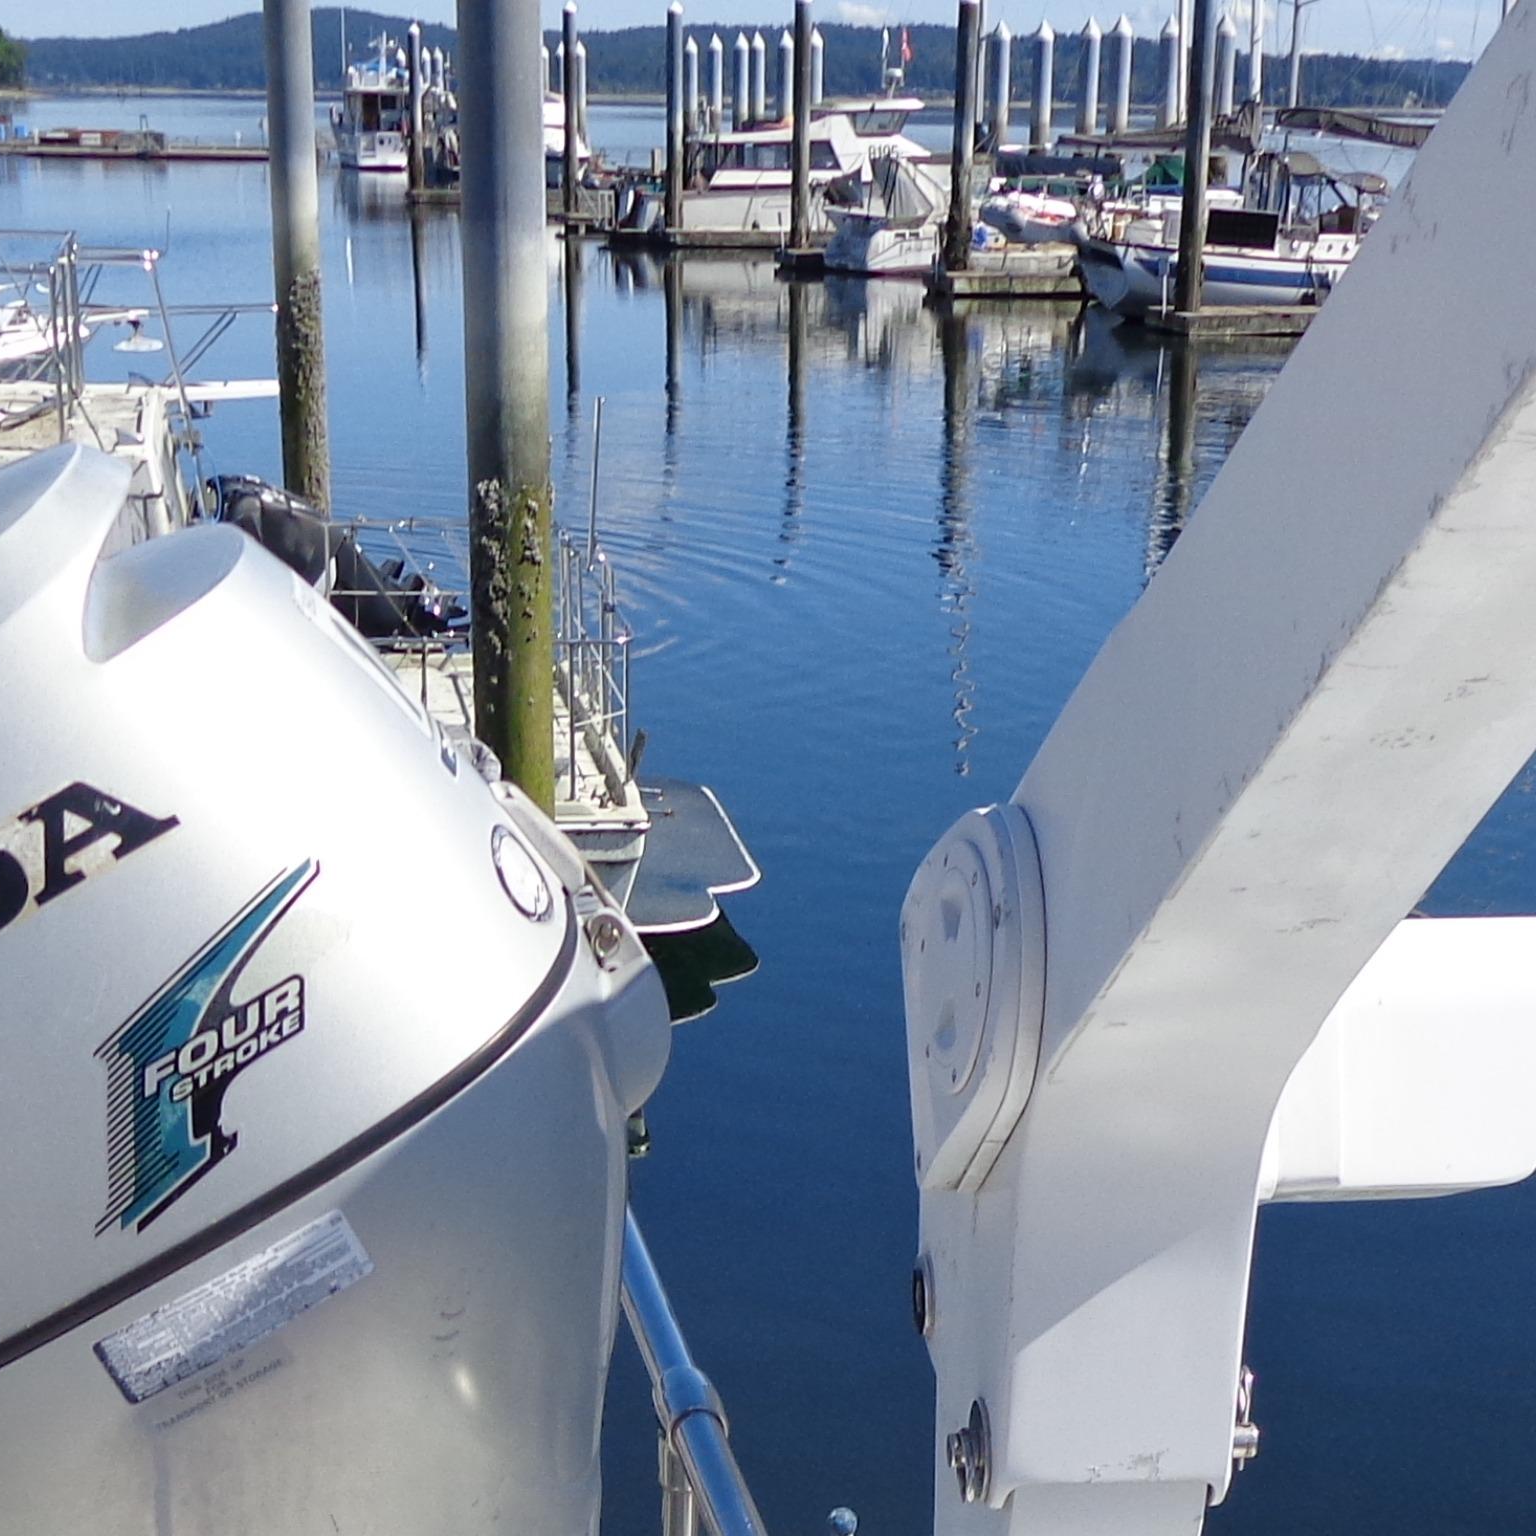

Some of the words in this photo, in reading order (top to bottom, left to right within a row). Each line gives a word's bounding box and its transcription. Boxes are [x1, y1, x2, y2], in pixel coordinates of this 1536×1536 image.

[143, 979, 301, 1099] FOUR
[171, 1011, 302, 1103] STROKE
[155, 1395, 217, 1431] TRANSPORT
[235, 1358, 284, 1389] STORAGE
